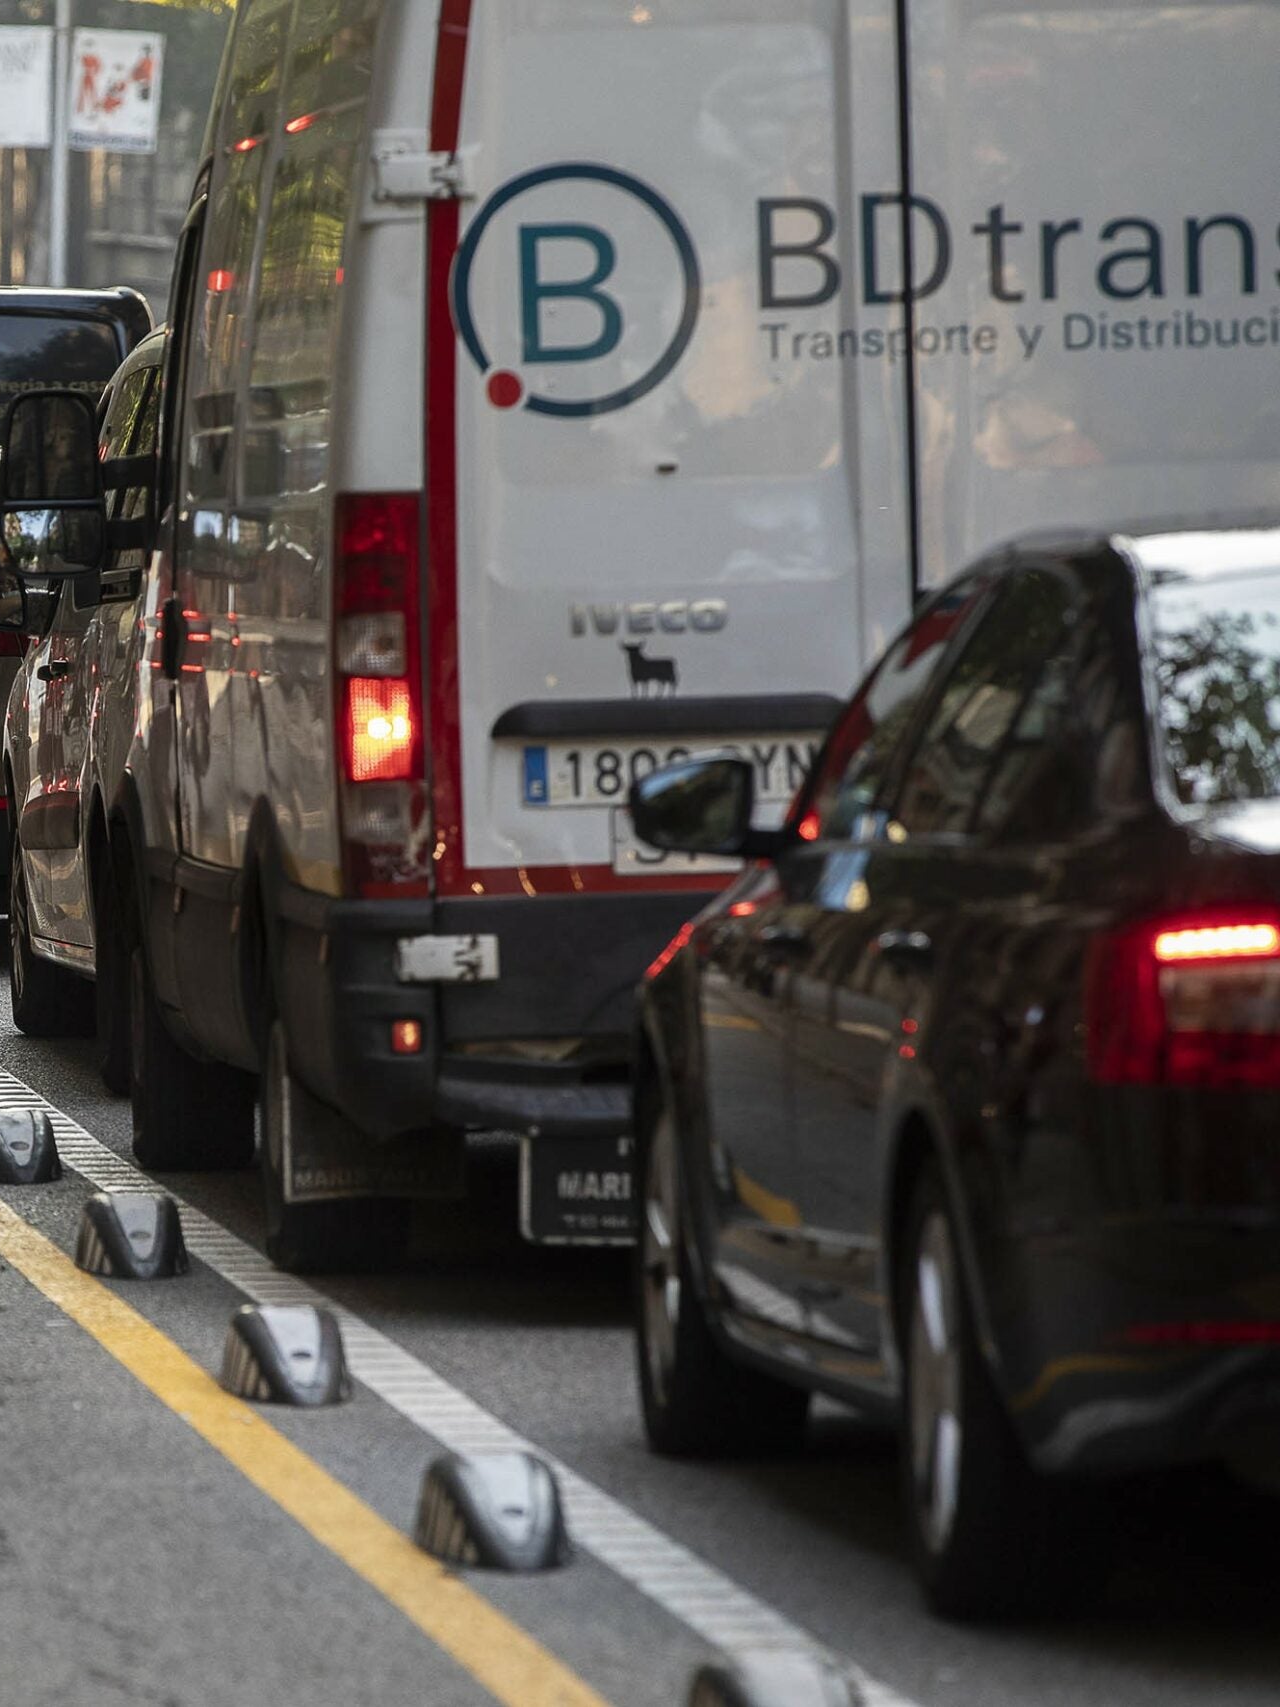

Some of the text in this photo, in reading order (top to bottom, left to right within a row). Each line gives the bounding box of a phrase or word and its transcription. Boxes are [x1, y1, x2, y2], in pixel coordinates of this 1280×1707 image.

[757, 192, 1280, 310] BDtran
[760, 320, 998, 363] Transporte
[1017, 325, 1044, 361] y
[568, 599, 728, 637] IVECO
